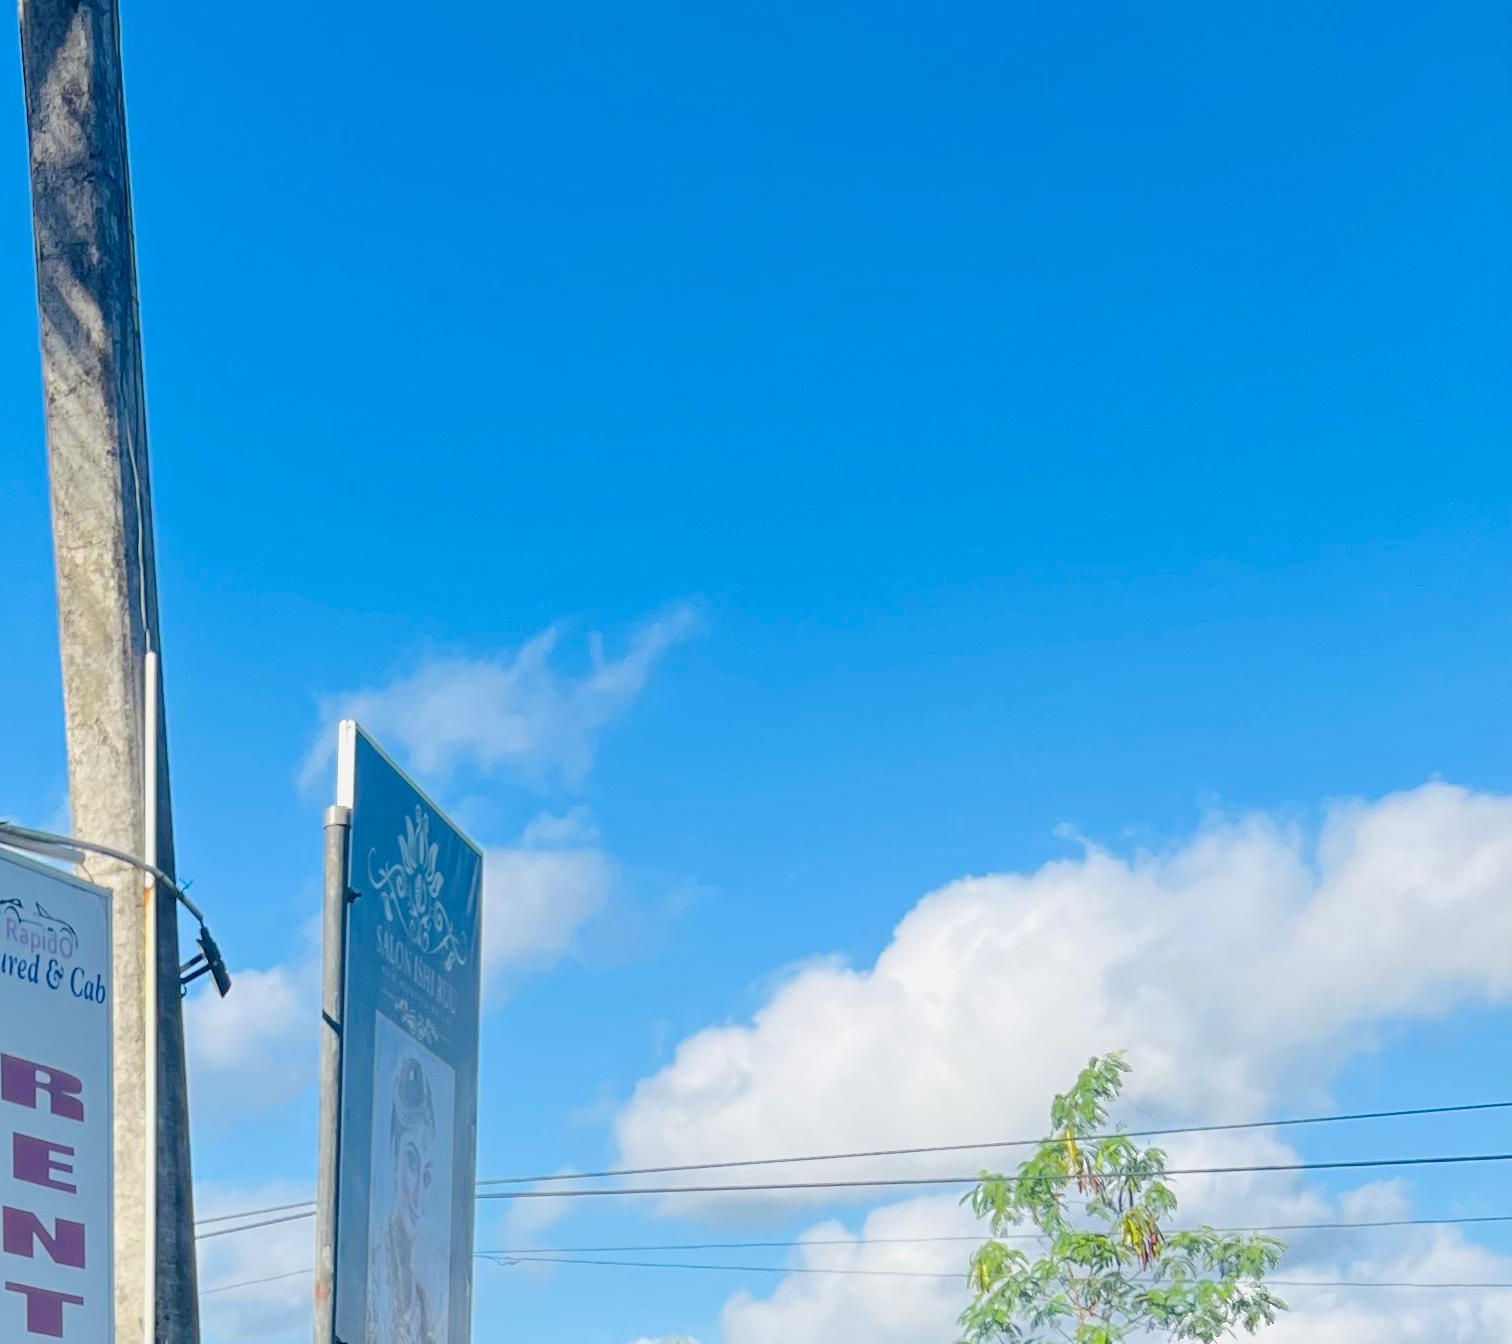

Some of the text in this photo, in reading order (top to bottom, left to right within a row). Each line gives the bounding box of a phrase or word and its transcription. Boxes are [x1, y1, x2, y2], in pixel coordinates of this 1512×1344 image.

[46, 959, 64, 990] &
[70, 967, 106, 1004] Cab
[1, 1053, 85, 1338] RENT
